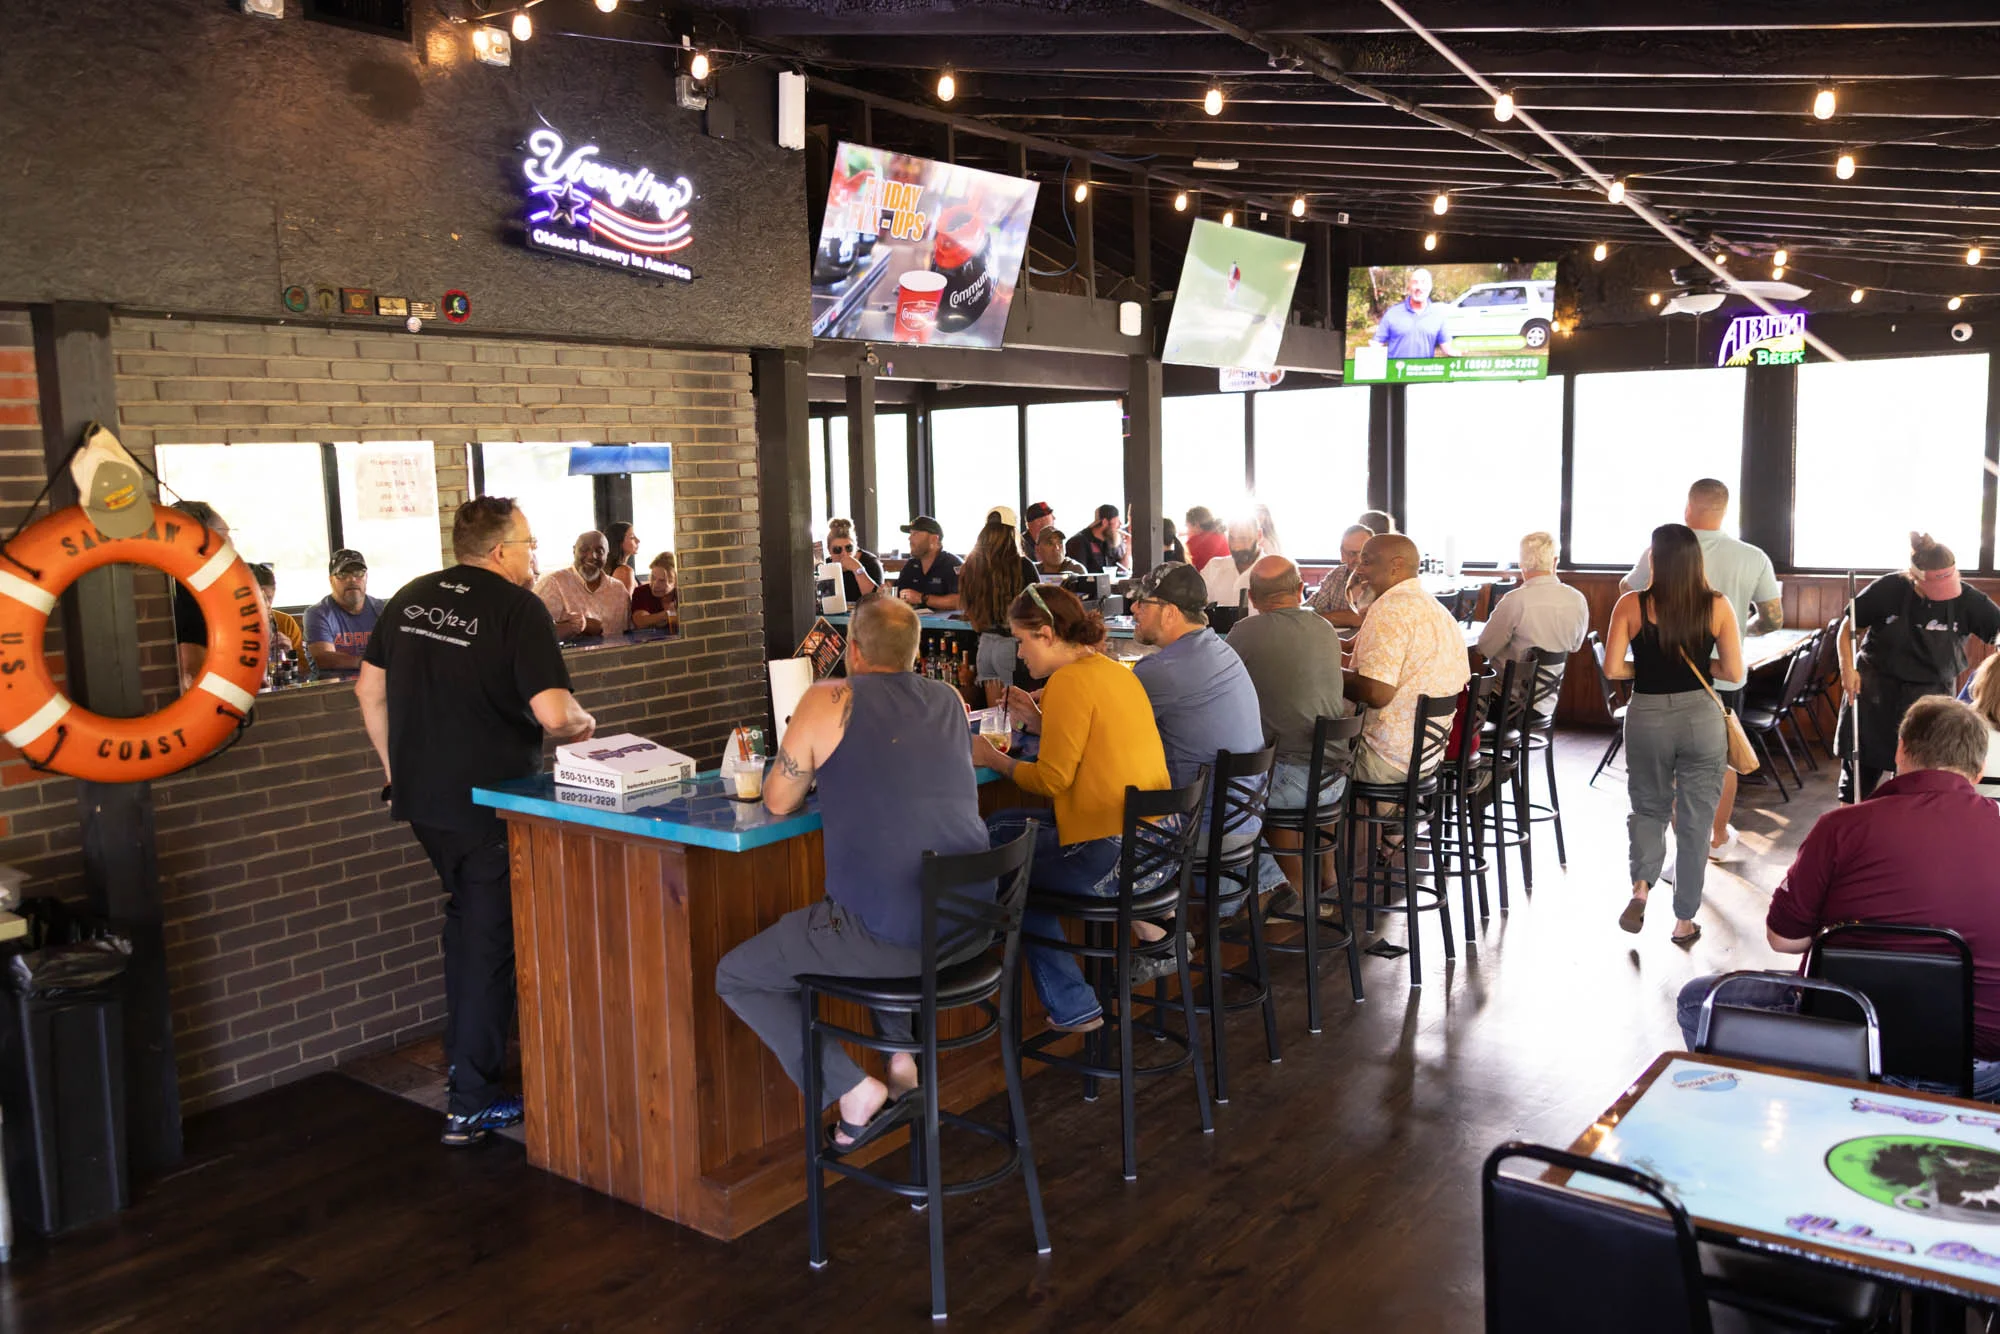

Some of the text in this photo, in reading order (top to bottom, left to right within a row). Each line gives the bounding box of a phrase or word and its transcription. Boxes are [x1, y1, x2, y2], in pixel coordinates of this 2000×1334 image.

[533, 229, 577, 251] Oldest
[579, 240, 630, 266] Brewery
[645, 257, 692, 280] America
[950, 271, 990, 308] Commun
[234, 586, 261, 668] GUARD
[97, 728, 188, 761] COAST
